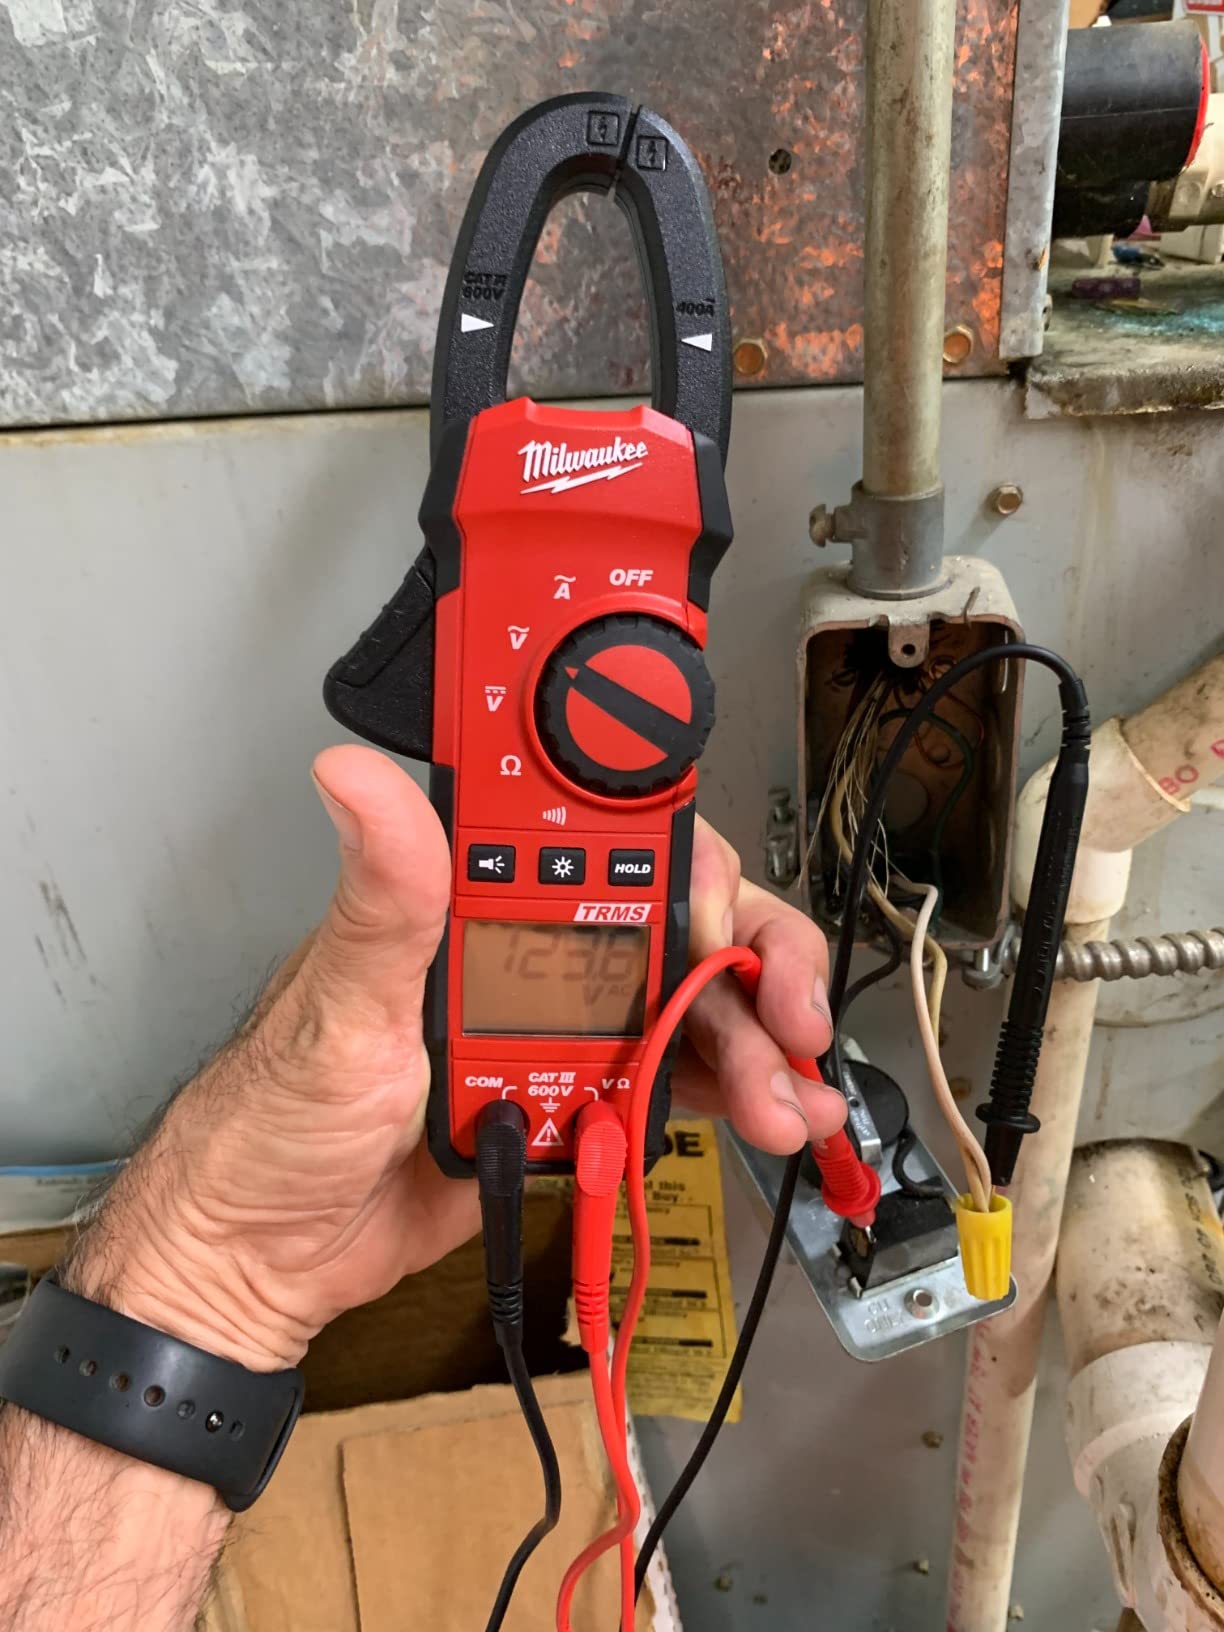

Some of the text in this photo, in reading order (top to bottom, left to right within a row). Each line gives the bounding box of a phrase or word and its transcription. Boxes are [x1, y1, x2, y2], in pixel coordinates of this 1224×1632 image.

[518, 436, 648, 482] Milwaukee
[609, 568, 653, 586] OFF
[615, 863, 651, 874] HOLD
[582, 905, 646, 921] TRMS
[465, 1076, 503, 1088] COM
[528, 1072, 558, 1083] CAT
